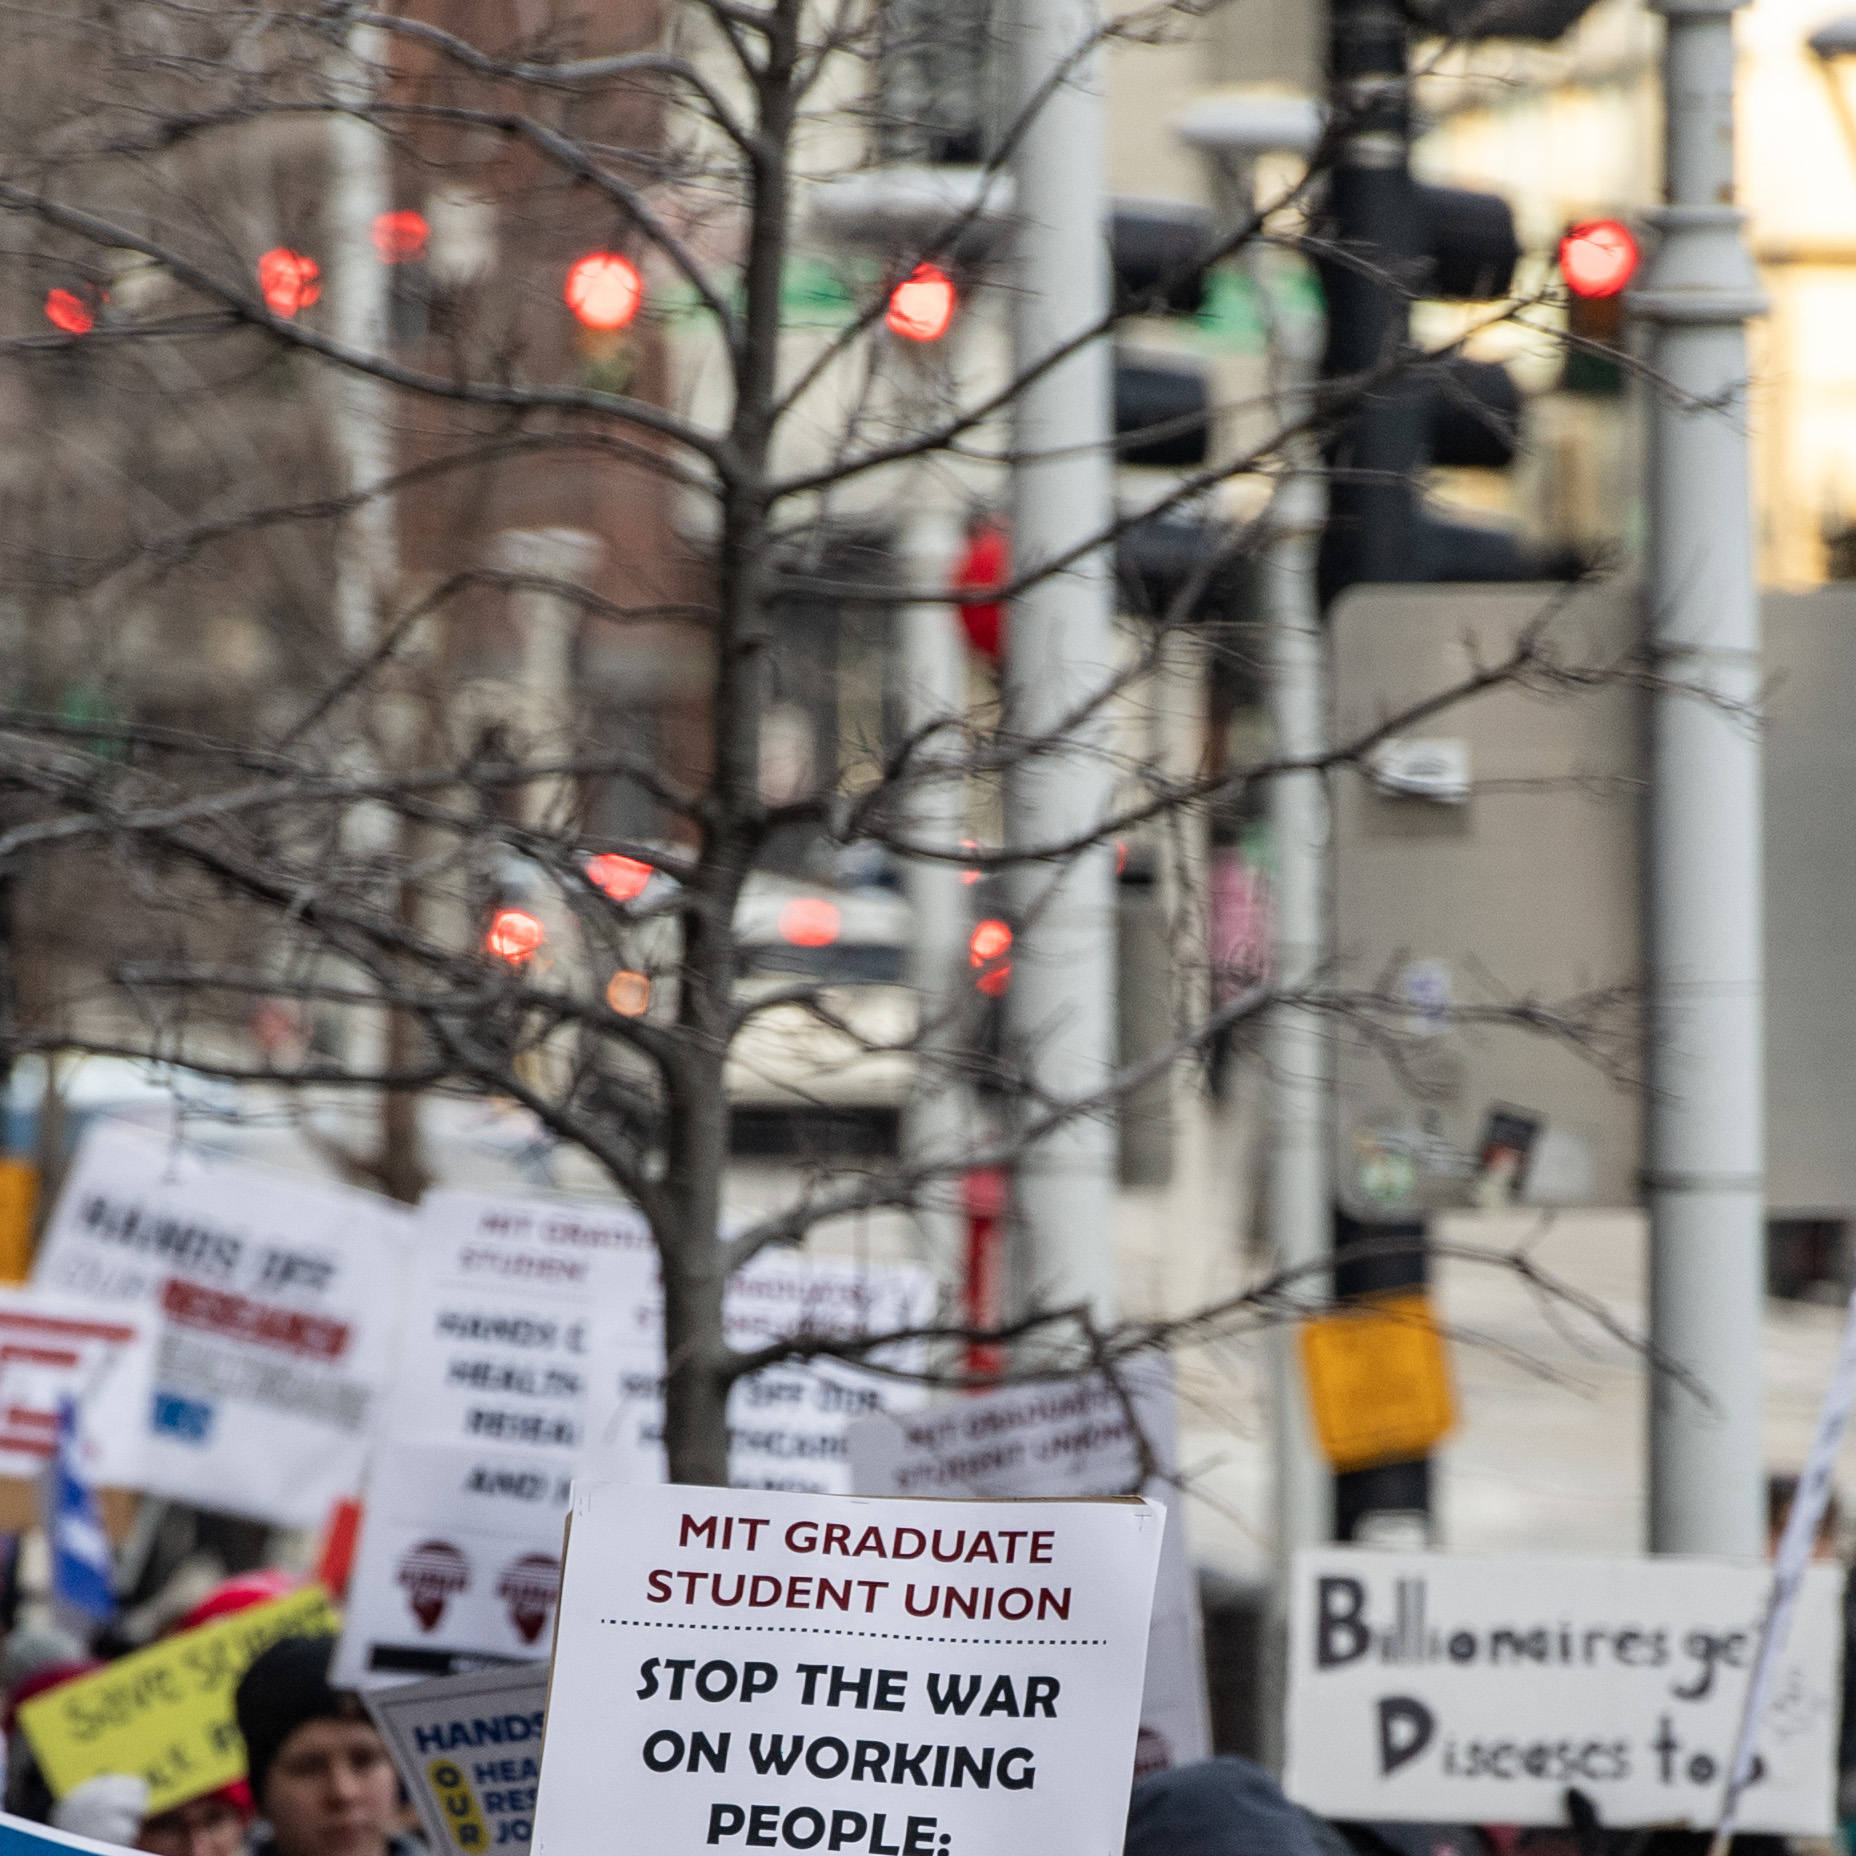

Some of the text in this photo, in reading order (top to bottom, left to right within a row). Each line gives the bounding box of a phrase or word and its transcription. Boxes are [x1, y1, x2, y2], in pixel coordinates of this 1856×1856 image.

[678, 1514, 1055, 1565] MIT GRADUATE
[646, 1569, 1072, 1621] STUDENT UNION
[636, 1656, 1061, 1718] STOP THE WAR
[412, 1710, 544, 1755] HANDS
[642, 1729, 1036, 1790] ON WORKING
